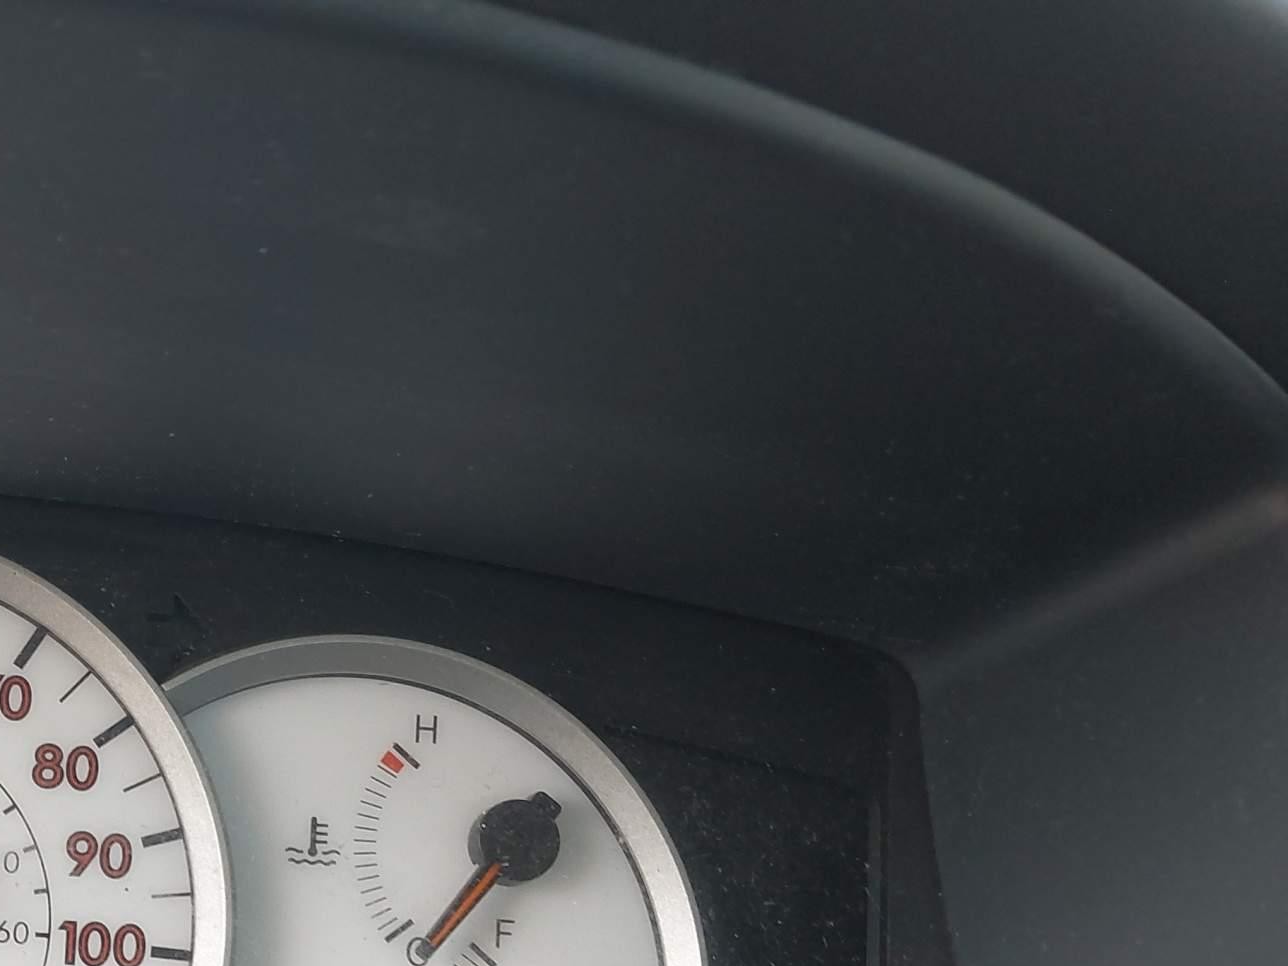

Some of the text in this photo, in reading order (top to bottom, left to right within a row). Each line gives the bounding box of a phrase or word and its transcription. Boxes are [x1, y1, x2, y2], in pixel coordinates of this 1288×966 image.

[416, 714, 437, 744] H
[32, 743, 99, 791] 80
[66, 831, 132, 879] 90
[496, 919, 515, 948] F
